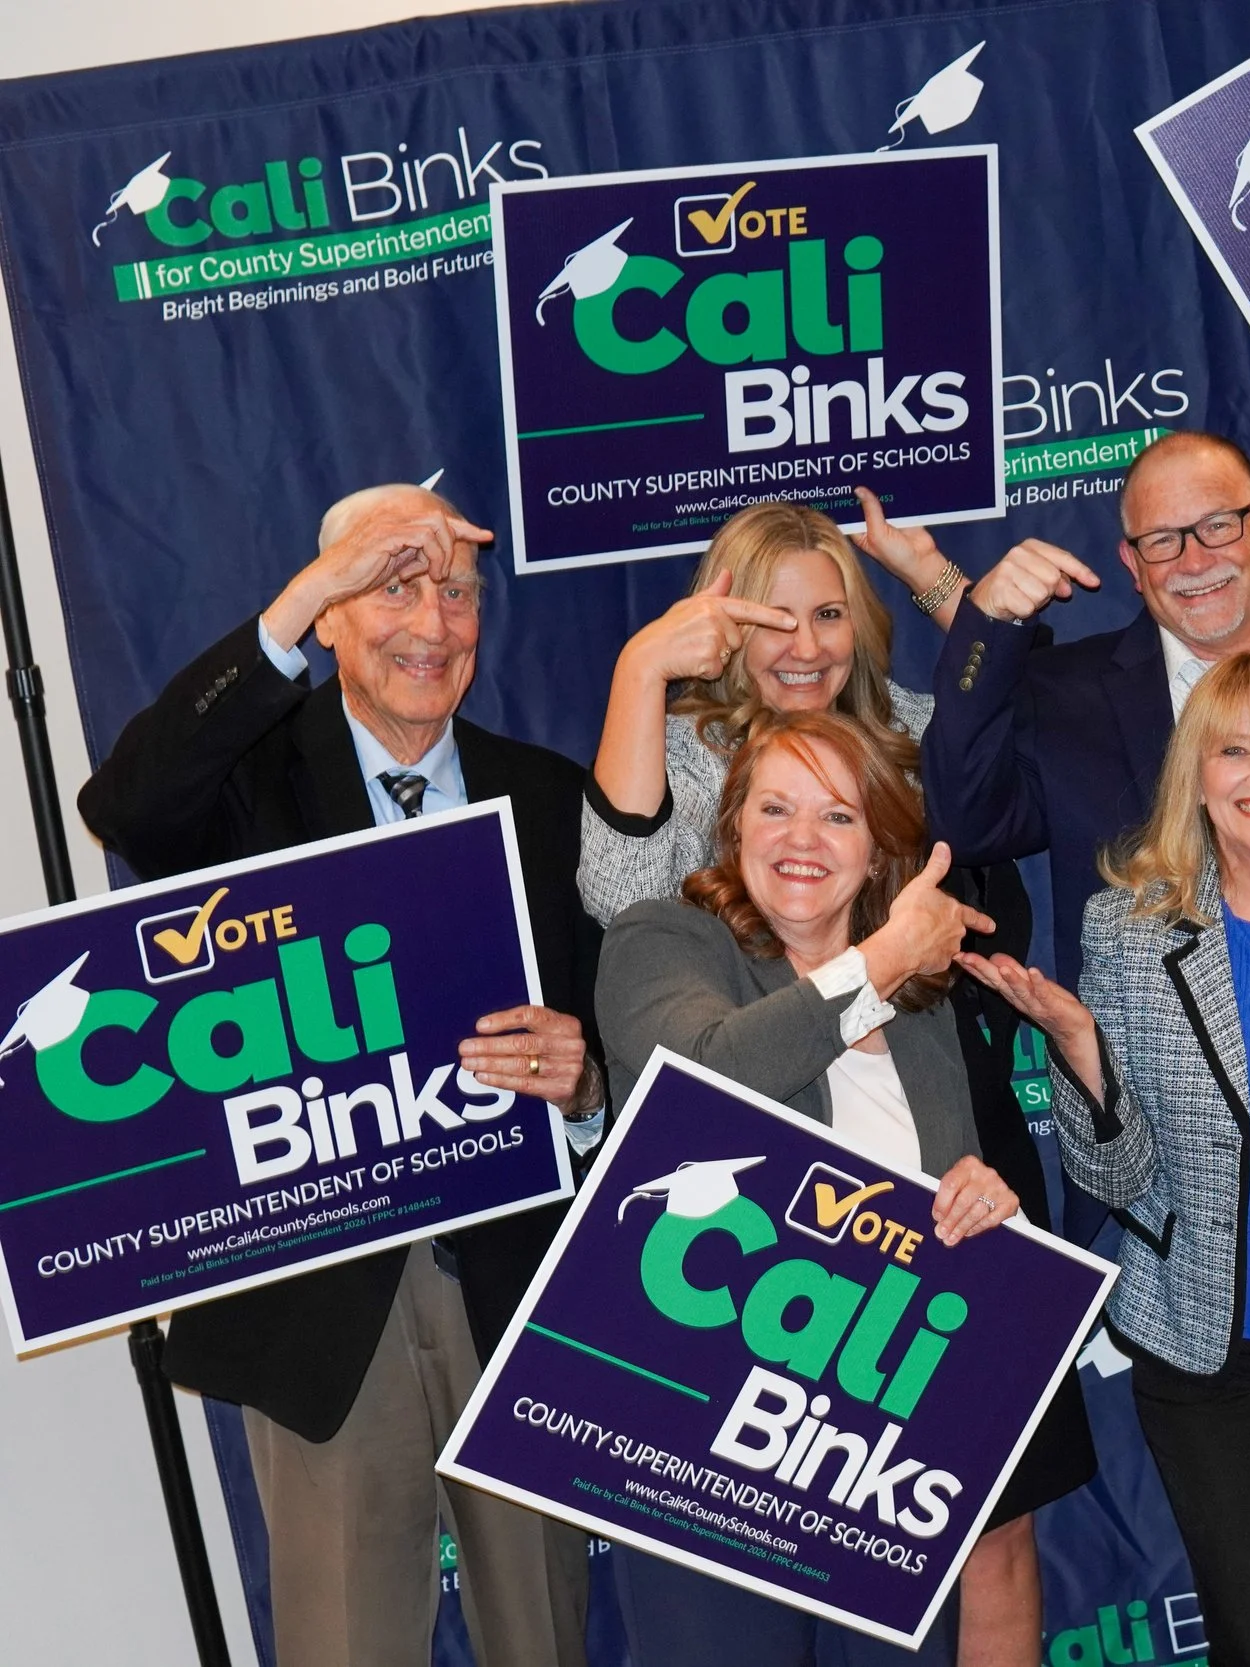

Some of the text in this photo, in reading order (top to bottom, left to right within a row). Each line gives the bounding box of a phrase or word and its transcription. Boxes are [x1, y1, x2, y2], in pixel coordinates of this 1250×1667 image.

[145, 127, 549, 248] Cali Binks
[155, 213, 492, 289] for County Superintenden
[162, 250, 494, 320] Bright Beginnings and Bold Future
[574, 235, 884, 375] Cali
[725, 357, 969, 454] Binks
[1002, 358, 1190, 440] Binks
[548, 441, 970, 505] COUNTY SUPERINTENDENT OF SCHOOLS
[1003, 437, 1138, 477] erintendent
[1026, 482, 1068, 503] Bold
[1072, 476, 1124, 497] Futur
[632, 522, 649, 533] Paid
[650, 521, 662, 531] for
[662, 519, 673, 531] by
[673, 518, 689, 528] Cali
[689, 515, 710, 526] Binks
[711, 513, 723, 524] for
[834, 498, 855, 509] FPPC
[35, 923, 406, 1122] Cali
[224, 1052, 516, 1186] Binks
[36, 1125, 524, 1275] COUNTY SUPERINTENDENT OF SCHOOLS
[139, 1275, 160, 1289] Paid
[160, 1271, 175, 1283] for
[174, 1267, 188, 1281] by
[187, 1262, 205, 1276] Cali
[205, 1255, 230, 1271] Binks
[230, 1251, 244, 1263] for
[244, 1242, 278, 1261] County
[277, 1223, 344, 1252] Superintendent
[343, 1216, 368, 1232] 2026
[372, 1208, 397, 1224] FPPC
[396, 1195, 443, 1217] #1484453
[187, 1196, 391, 1260] www.Cali4CountySchools.com
[641, 1195, 969, 1420] Cali
[513, 1397, 928, 1574] COUNTY SUPERINTENDENT OF SCHOOLS
[710, 1366, 963, 1538] Binks
[571, 1477, 593, 1492] Paid
[589, 1484, 605, 1497] for
[600, 1488, 617, 1503] by
[612, 1493, 632, 1507] Cali
[628, 1499, 654, 1516] Binks
[650, 1507, 666, 1520] for
[661, 1511, 694, 1533] County
[689, 1522, 751, 1554] Superintendent
[746, 1544, 771, 1560] 2026
[770, 1553, 795, 1570] FPPC
[791, 1561, 833, 1584] #1484453
[625, 1480, 799, 1555] www.Cali4CountySchools.com
[1050, 1600, 1155, 1667] ali
